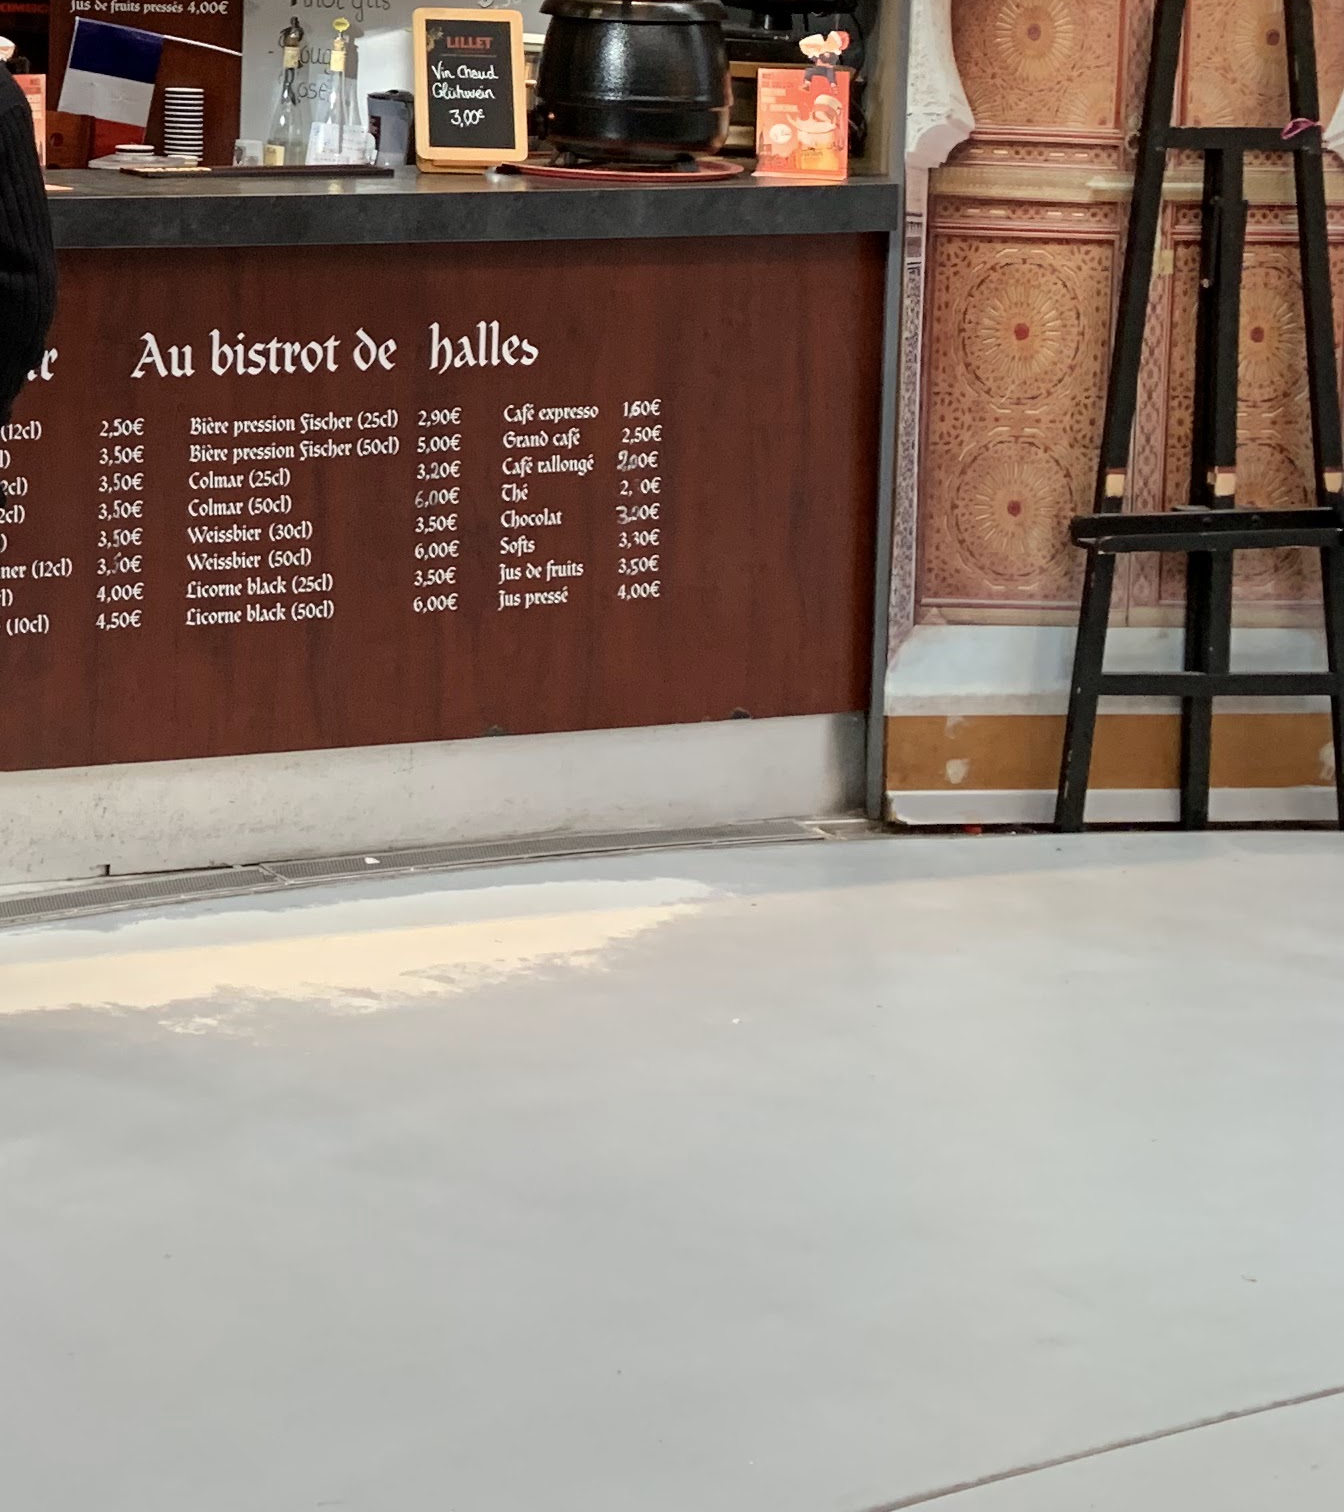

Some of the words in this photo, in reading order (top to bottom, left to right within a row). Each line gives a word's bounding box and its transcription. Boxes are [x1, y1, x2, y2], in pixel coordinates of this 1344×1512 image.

[94, 0, 108, 11] de
[143, 1, 184, 15] pressés
[187, 0, 229, 15] 4,00€
[446, 36, 494, 49] LILLET
[431, 60, 455, 80] Vin
[457, 65, 499, 80] Chaud
[129, 331, 195, 379] Au
[209, 328, 340, 377] bistrot
[351, 327, 397, 372] de
[427, 320, 540, 376] halles
[190, 416, 229, 436] Bière
[233, 414, 296, 438] pression
[299, 411, 353, 434] Fischer
[357, 409, 399, 430] (25cl)
[417, 407, 462, 427] 2,90€
[503, 403, 534, 425] Café
[538, 405, 599, 424] expresso
[0, 420, 42, 441] (12cl)
[99, 418, 145, 438] 2,50€
[502, 430, 548, 449] Grand
[552, 427, 581, 449] café
[621, 425, 663, 445] 2,50€
[99, 445, 145, 466] 3,50€
[189, 444, 228, 463] Bière
[232, 442, 295, 465] pression
[298, 438, 352, 462] Fischer
[356, 436, 400, 458] (50cl)
[416, 434, 462, 454] 5,00€
[502, 455, 534, 477] Café
[537, 454, 594, 476] rallongé
[98, 472, 144, 494] 3,50€
[188, 470, 244, 490] Colmar
[248, 467, 291, 489] (25cl)
[501, 483, 528, 502] Thé
[97, 500, 144, 520] 3,50€
[187, 497, 244, 517] Colmar
[248, 494, 292, 516] (50cl)
[186, 524, 262, 544] Weissbier
[268, 521, 313, 542] (30cl)
[414, 513, 458, 533] 3,50€
[500, 508, 563, 529] Chocolat
[97, 528, 143, 548] 3,50€
[499, 535, 536, 557] Softs
[186, 551, 262, 571] Weissbier
[268, 547, 312, 569] (50cl)
[414, 540, 460, 559] 6,00€
[31, 558, 73, 579] (12cl)
[498, 563, 522, 585] Jus
[525, 562, 542, 578] de
[546, 559, 584, 581] fruits
[618, 554, 660, 576] 3,50€
[96, 583, 144, 603] 4,00€
[185, 580, 242, 599] Licorne
[246, 575, 287, 596] black
[291, 573, 334, 595] (25cl)
[413, 566, 457, 587] 3,50€
[497, 590, 521, 611] Jus
[524, 586, 569, 609] pressé
[617, 580, 661, 601] 4,00€
[185, 607, 242, 626] Licorne
[246, 603, 287, 623] black
[290, 600, 335, 622] (50cl)
[413, 593, 459, 614] 6,00€
[6, 614, 50, 637] (10cl)
[95, 610, 142, 630] 4,50€
